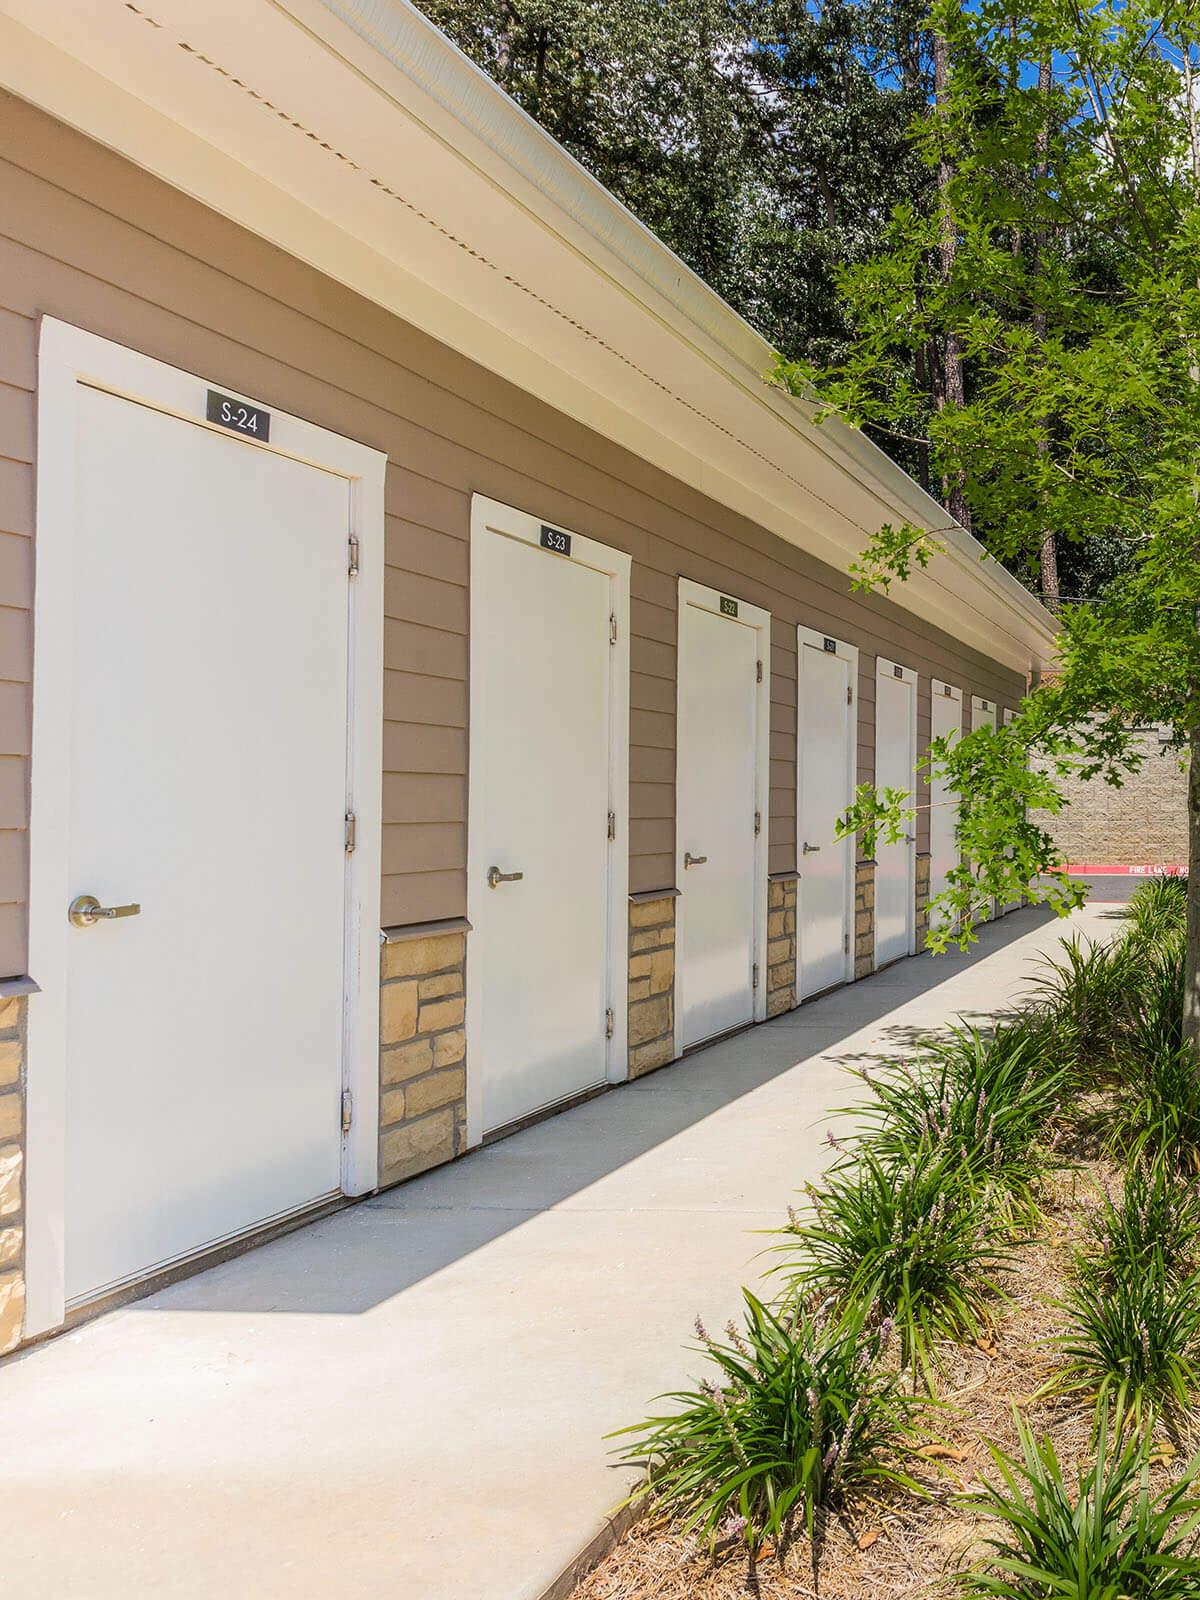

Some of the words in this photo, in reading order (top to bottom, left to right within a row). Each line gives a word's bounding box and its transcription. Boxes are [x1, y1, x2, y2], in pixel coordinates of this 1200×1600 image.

[221, 402, 258, 432] S-24
[547, 532, 566, 550] S-23
[1129, 865, 1146, 874] FIRE
